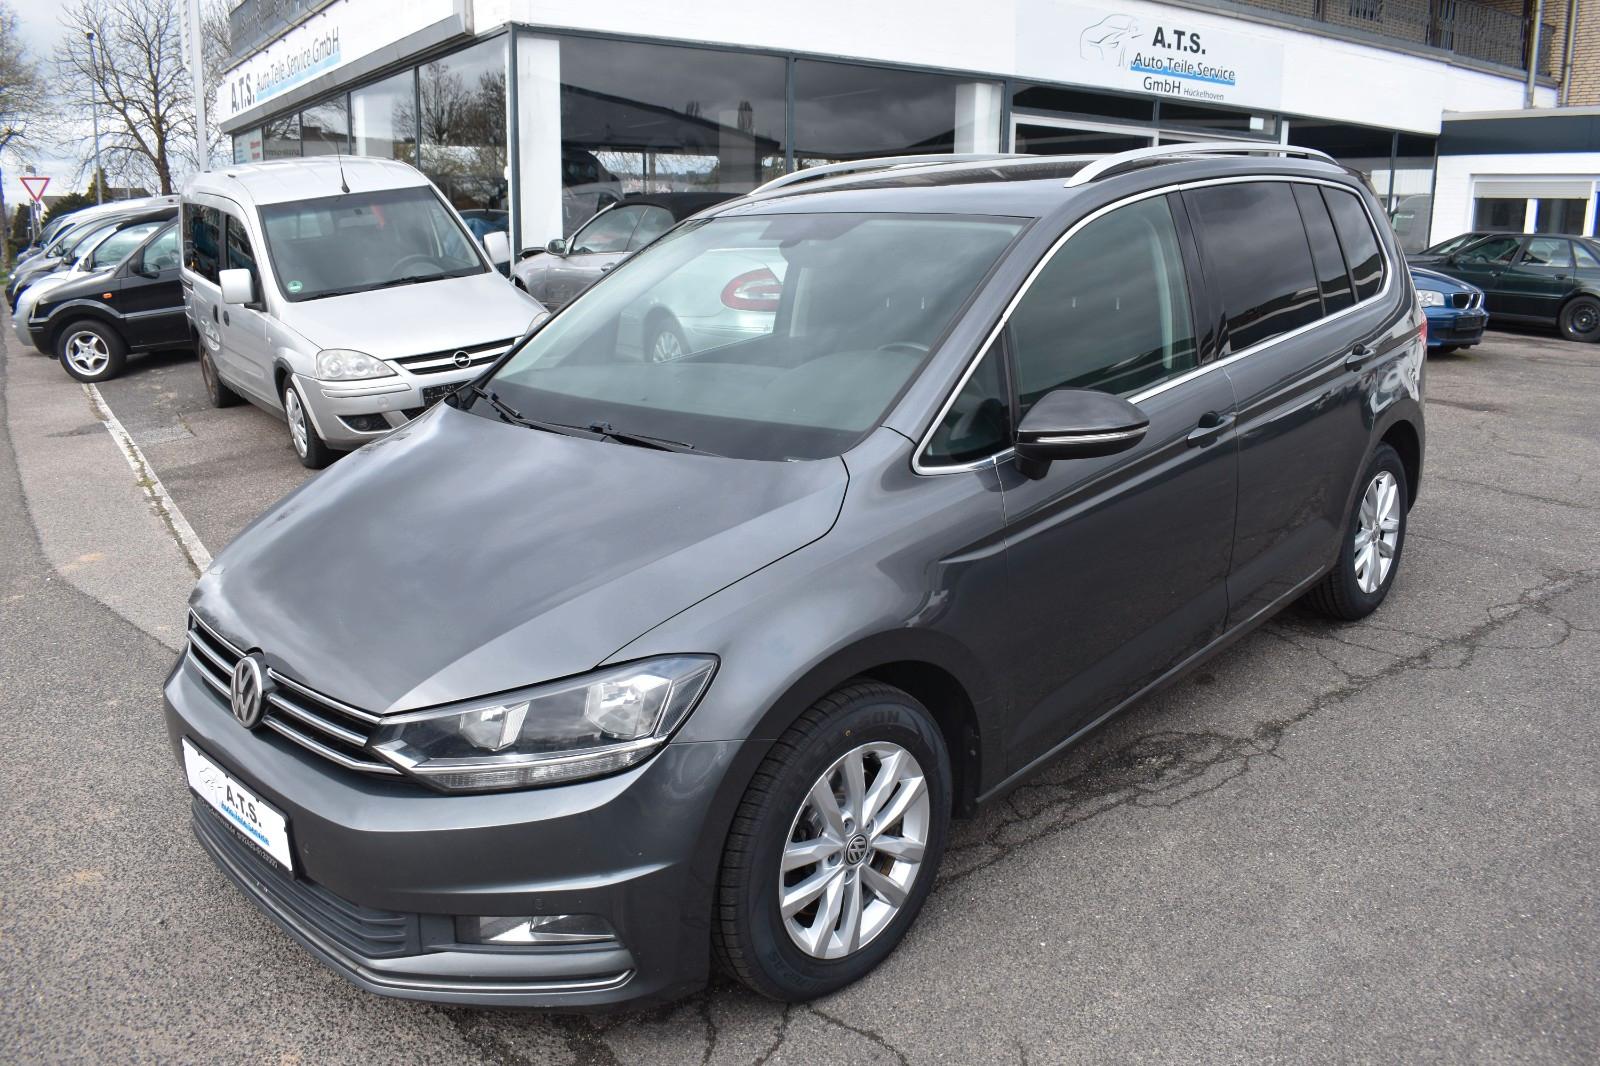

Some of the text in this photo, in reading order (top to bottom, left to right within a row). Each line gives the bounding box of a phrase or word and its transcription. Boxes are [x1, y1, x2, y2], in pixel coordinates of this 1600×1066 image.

[1152, 26, 1206, 55] A.T.S.
[231, 72, 255, 114] A.T.S.
[287, 47, 311, 78] Service
[312, 26, 340, 63] GmbH
[1133, 52, 1236, 81] Auto Teile Service
[1143, 76, 1181, 95] GmbH
[226, 785, 262, 828] A.T.S.
